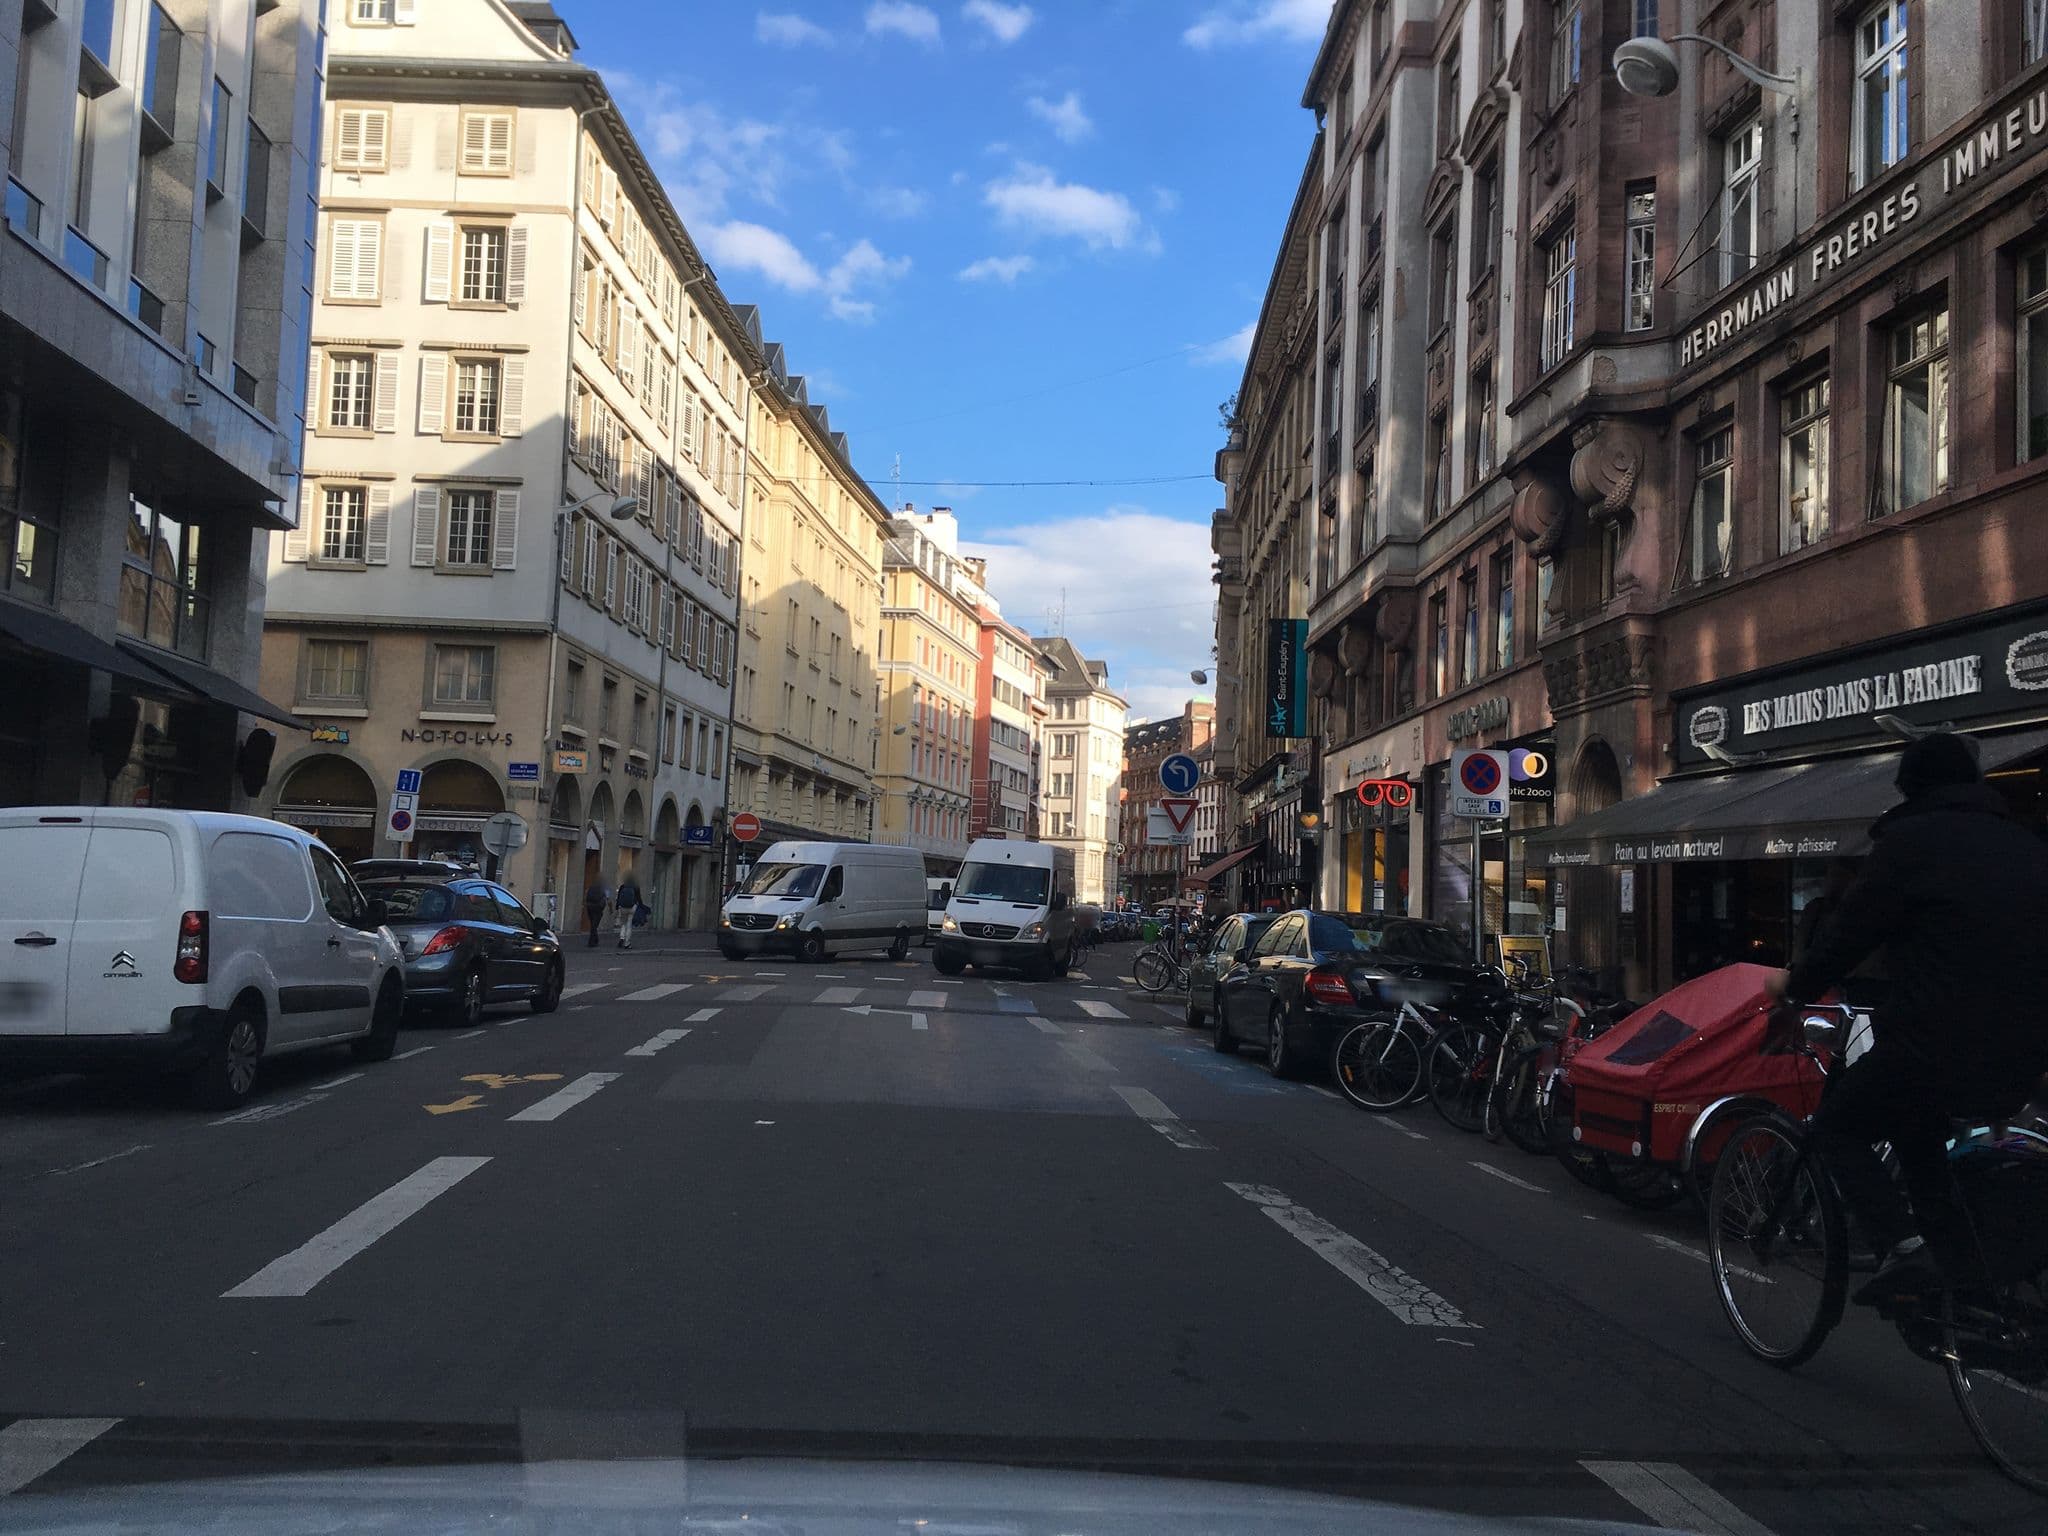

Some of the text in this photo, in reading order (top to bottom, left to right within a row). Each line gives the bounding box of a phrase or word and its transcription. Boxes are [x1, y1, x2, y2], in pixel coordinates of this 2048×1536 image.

[1681, 266, 1793, 367] HERRMANN
[1943, 91, 2046, 194] IMMEU
[1774, 688, 1824, 728] MAINS
[1826, 678, 1871, 718] DANS
[1874, 673, 1899, 710] LA
[1903, 655, 1981, 704] FARINE
[1527, 788, 1552, 797] 2000
[1615, 836, 1723, 860] Pain au levain naturel
[1764, 837, 1837, 856] Maître pâtissier
